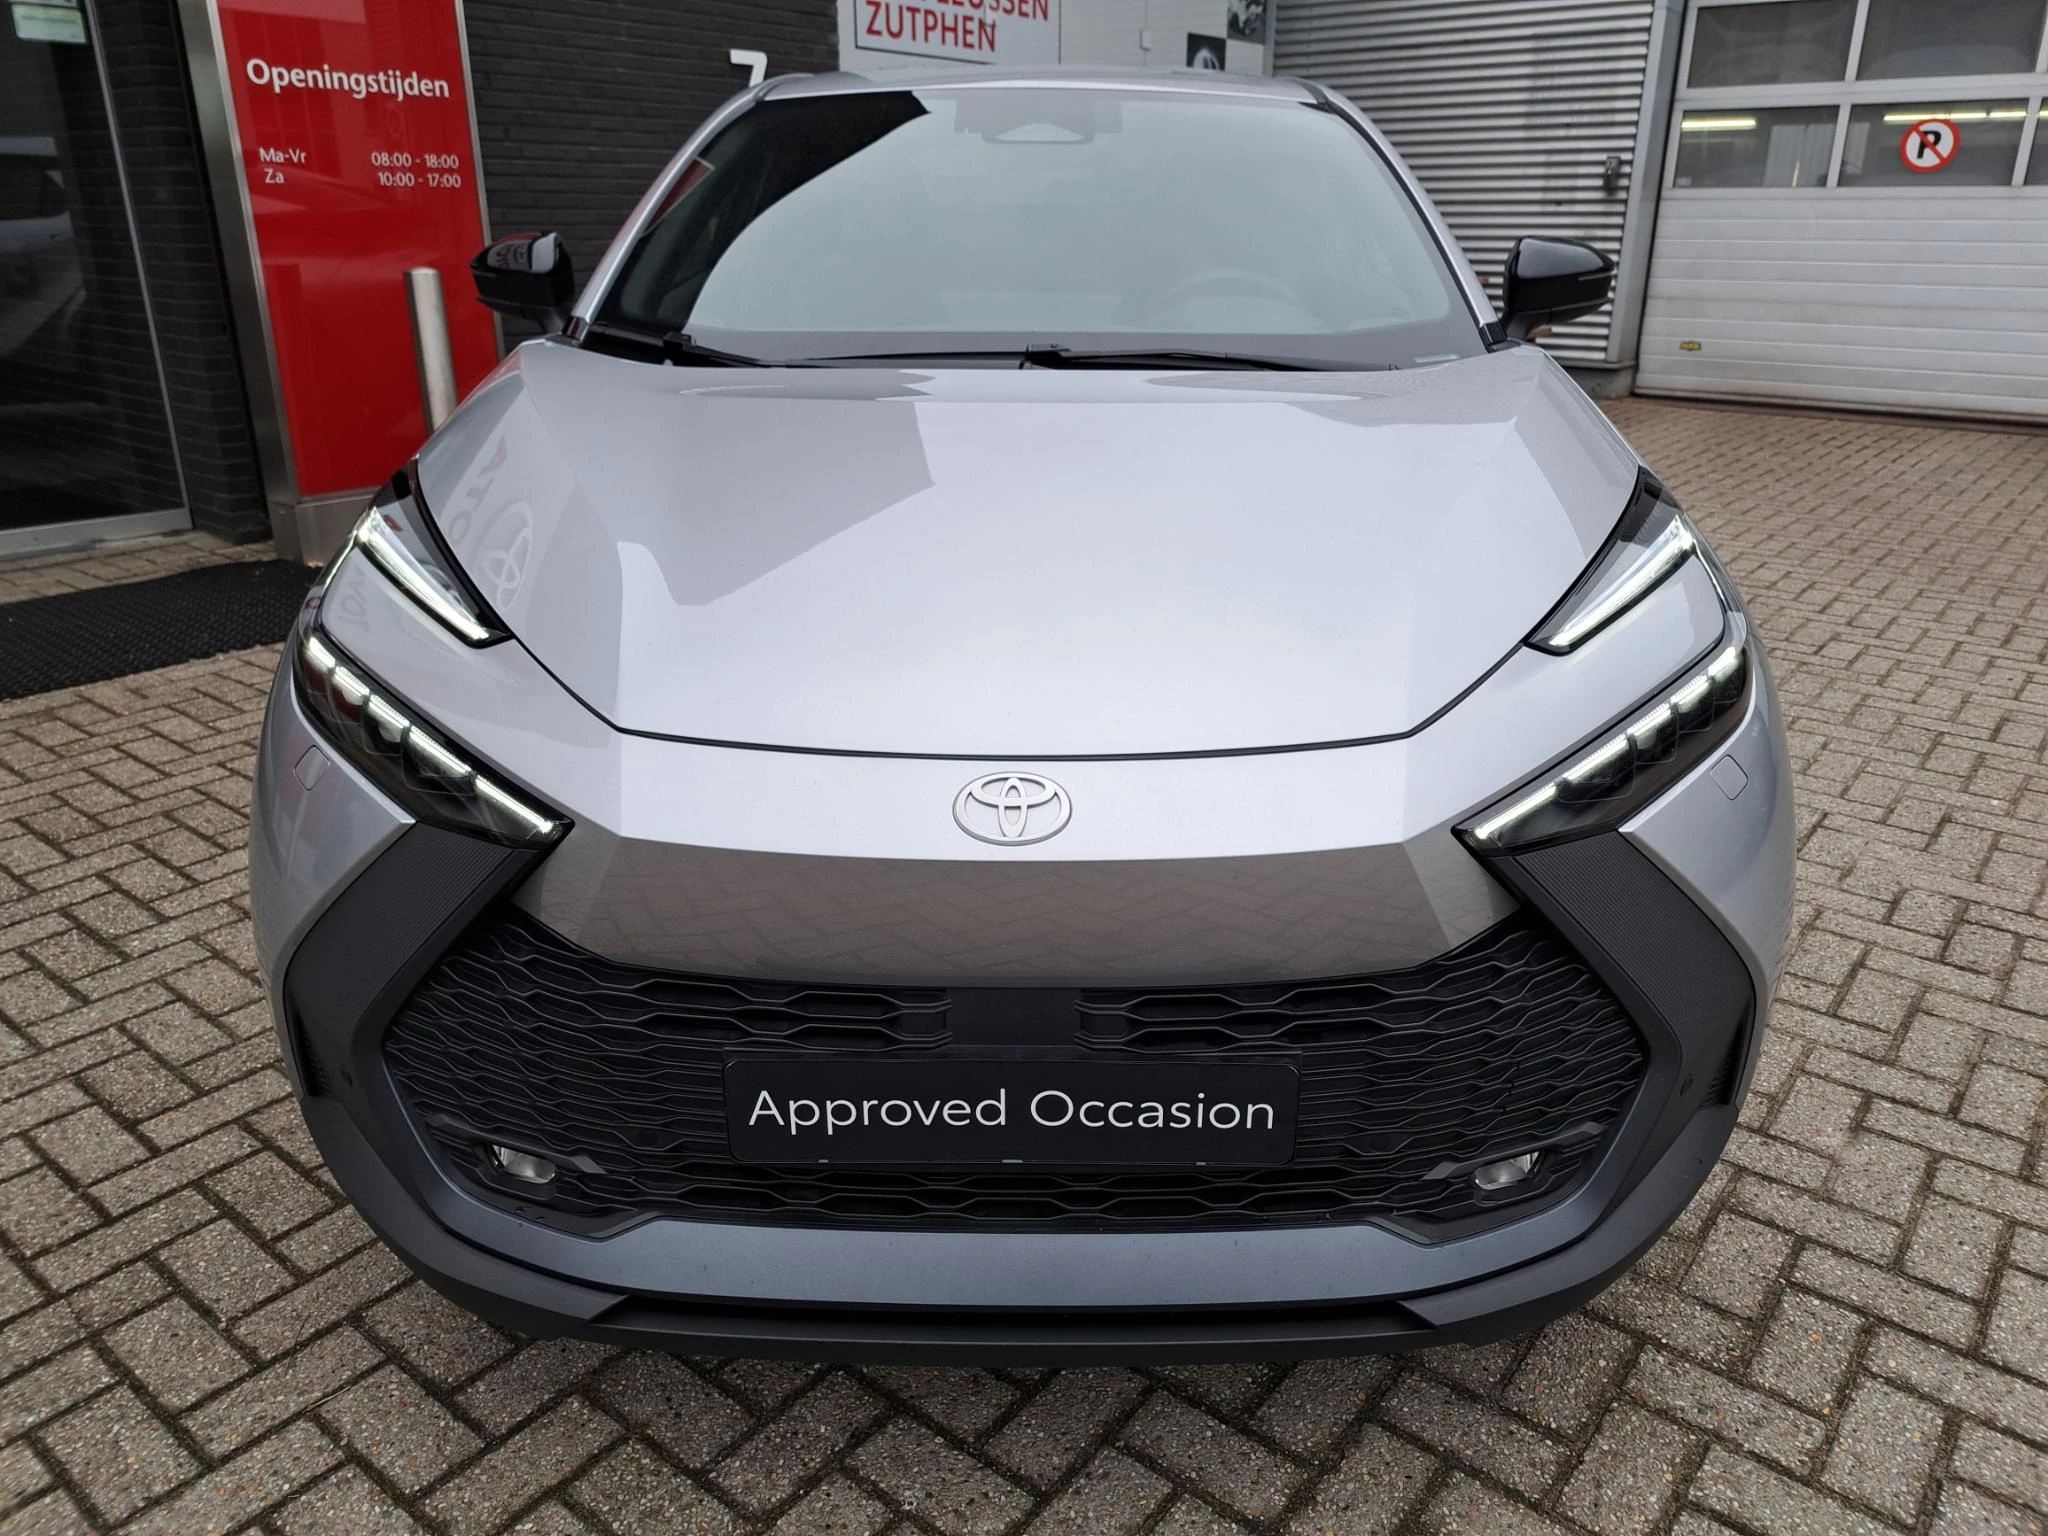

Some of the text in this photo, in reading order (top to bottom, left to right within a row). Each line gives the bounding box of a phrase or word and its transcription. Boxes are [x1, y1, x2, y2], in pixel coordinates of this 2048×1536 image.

[866, 1, 997, 52] ZUTPHEN
[246, 57, 450, 102] Openingstijden
[730, 49, 768, 88] 7
[259, 147, 307, 165] Ma-Vr
[371, 152, 412, 167] 08:00
[425, 153, 460, 169] 18:00
[263, 167, 285, 185] Za
[377, 171, 415, 187] 10:00
[427, 172, 462, 188] 17:00
[749, 1088, 1275, 1136] Approved Occasion
